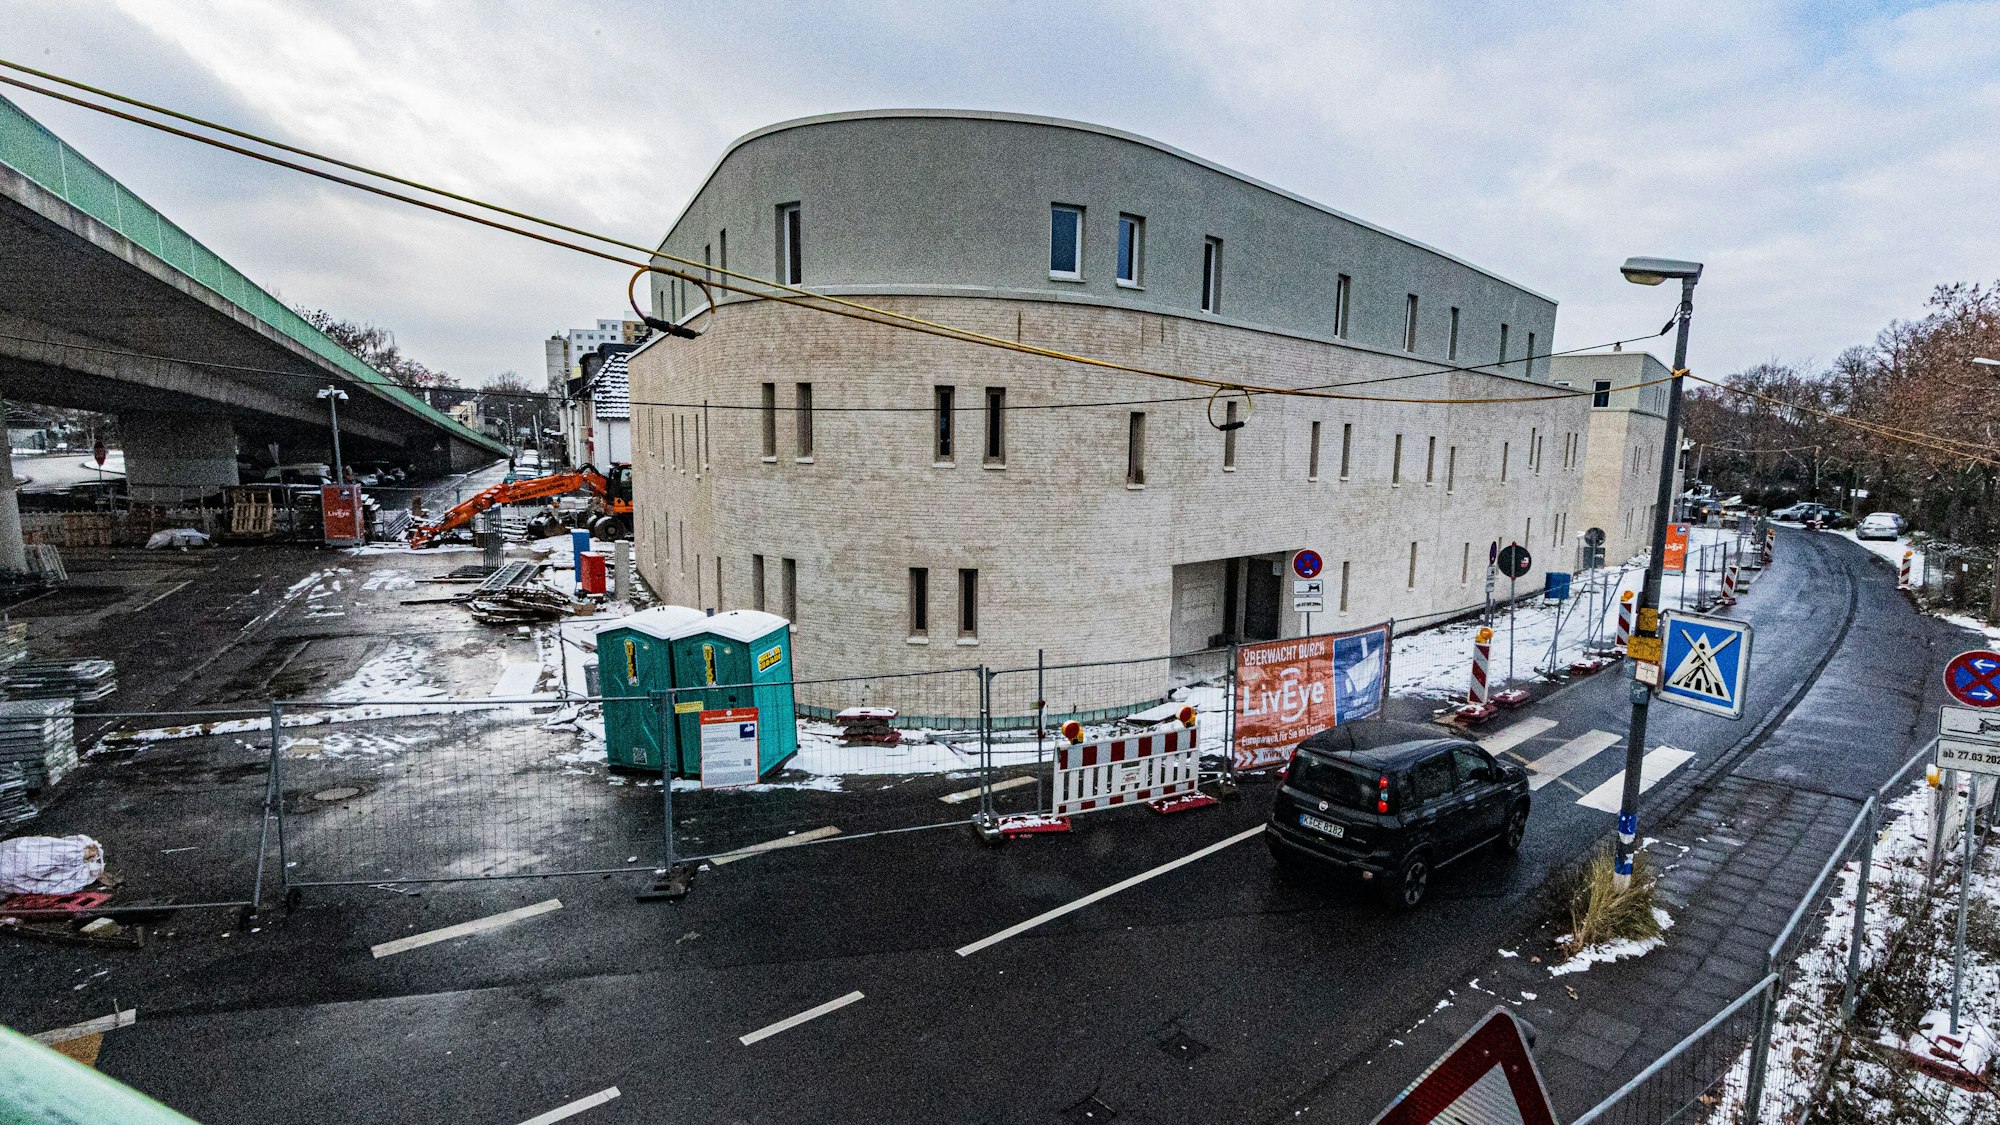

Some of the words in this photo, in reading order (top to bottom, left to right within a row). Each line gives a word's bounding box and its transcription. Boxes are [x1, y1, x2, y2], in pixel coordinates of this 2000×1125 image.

[1243, 646, 1297, 666] ÜBERWACHT
[1299, 641, 1325, 659] DURCH
[1243, 668, 1325, 722] LivEye
